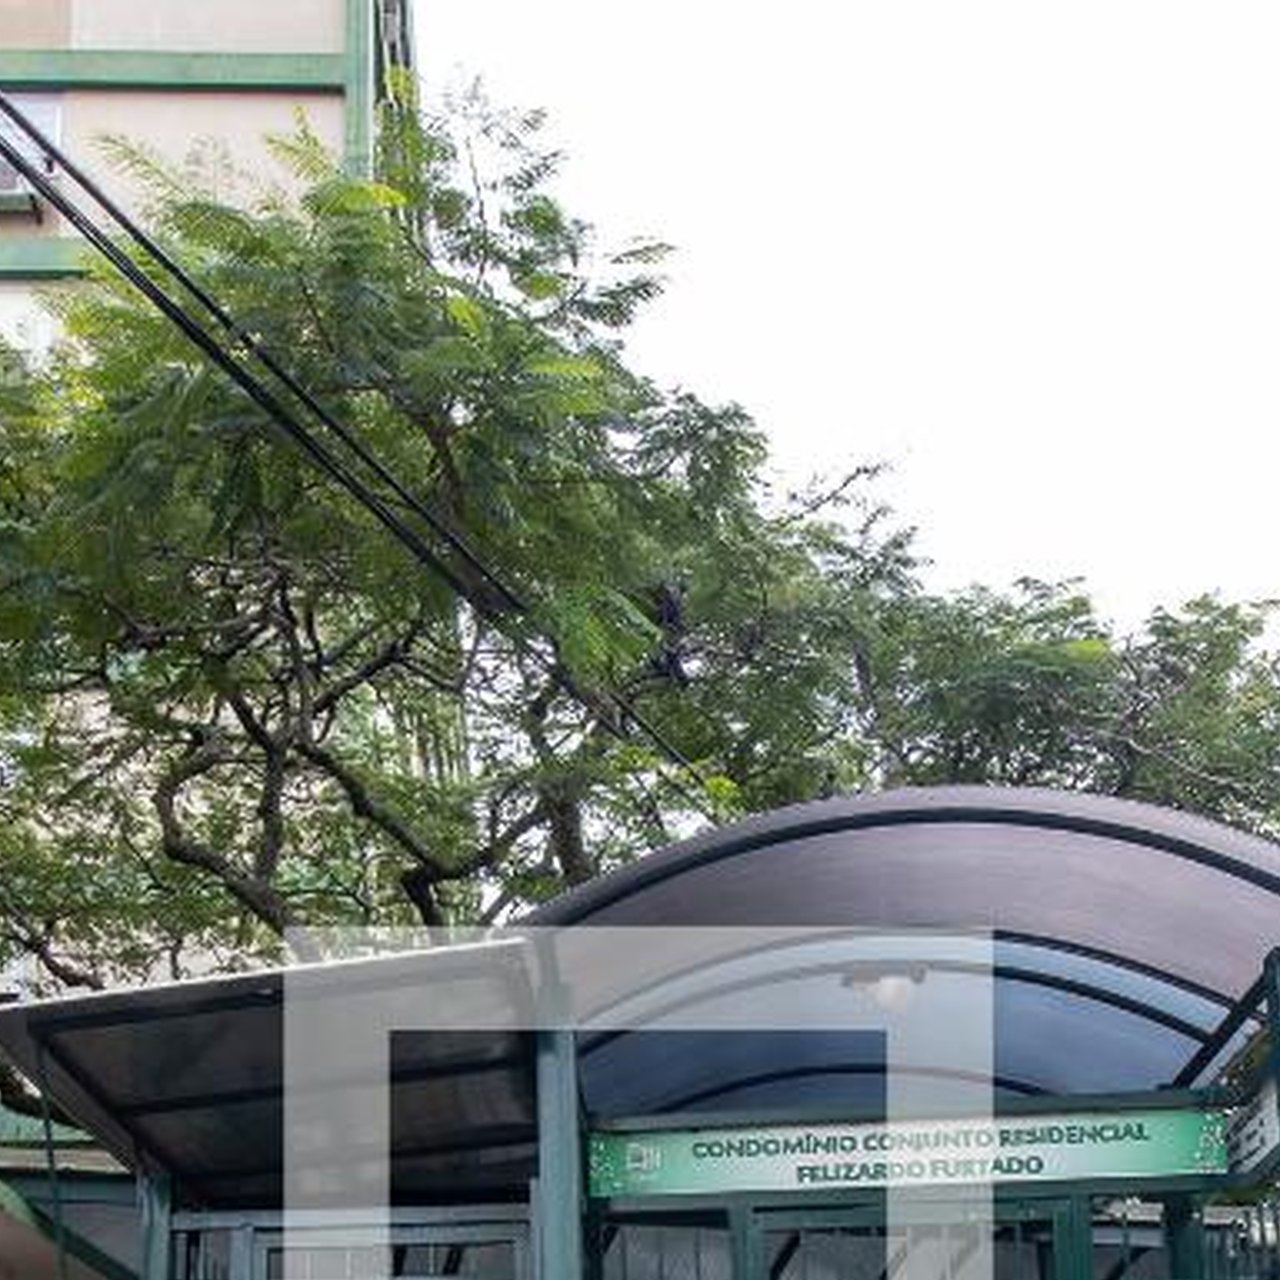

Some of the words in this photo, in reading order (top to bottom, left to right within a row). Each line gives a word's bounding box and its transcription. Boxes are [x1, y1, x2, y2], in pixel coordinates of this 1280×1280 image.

[692, 1134, 857, 1158] CONDOMÍNIO
[863, 1129, 993, 1151] CONJUNTO
[999, 1122, 1150, 1148] RESIDENCIAL
[796, 1161, 924, 1184] FELIZARDO
[931, 1155, 1044, 1178] FURTADO
